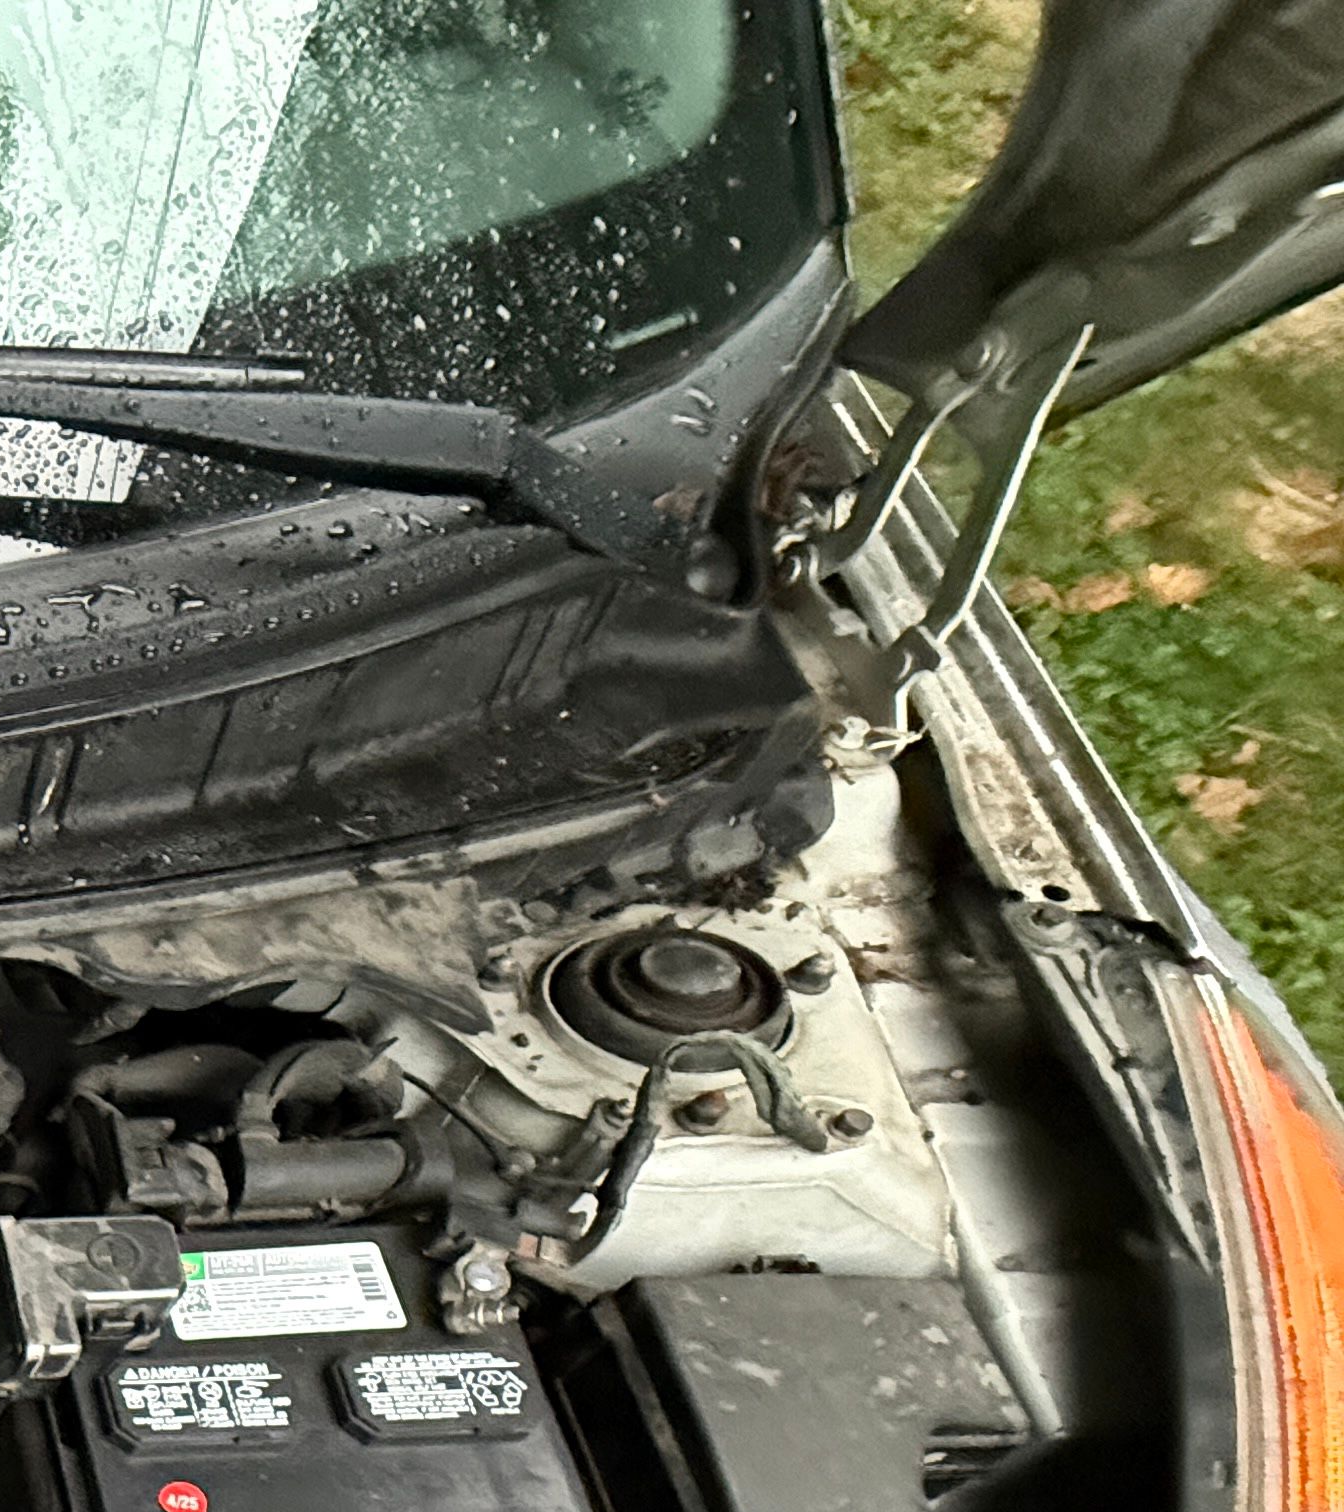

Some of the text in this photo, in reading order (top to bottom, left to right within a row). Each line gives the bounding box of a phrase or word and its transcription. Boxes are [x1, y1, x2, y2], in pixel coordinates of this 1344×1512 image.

[138, 1365, 199, 1380] DANGER
[213, 1363, 270, 1377] POISON
[166, 1493, 200, 1511] 4/25
